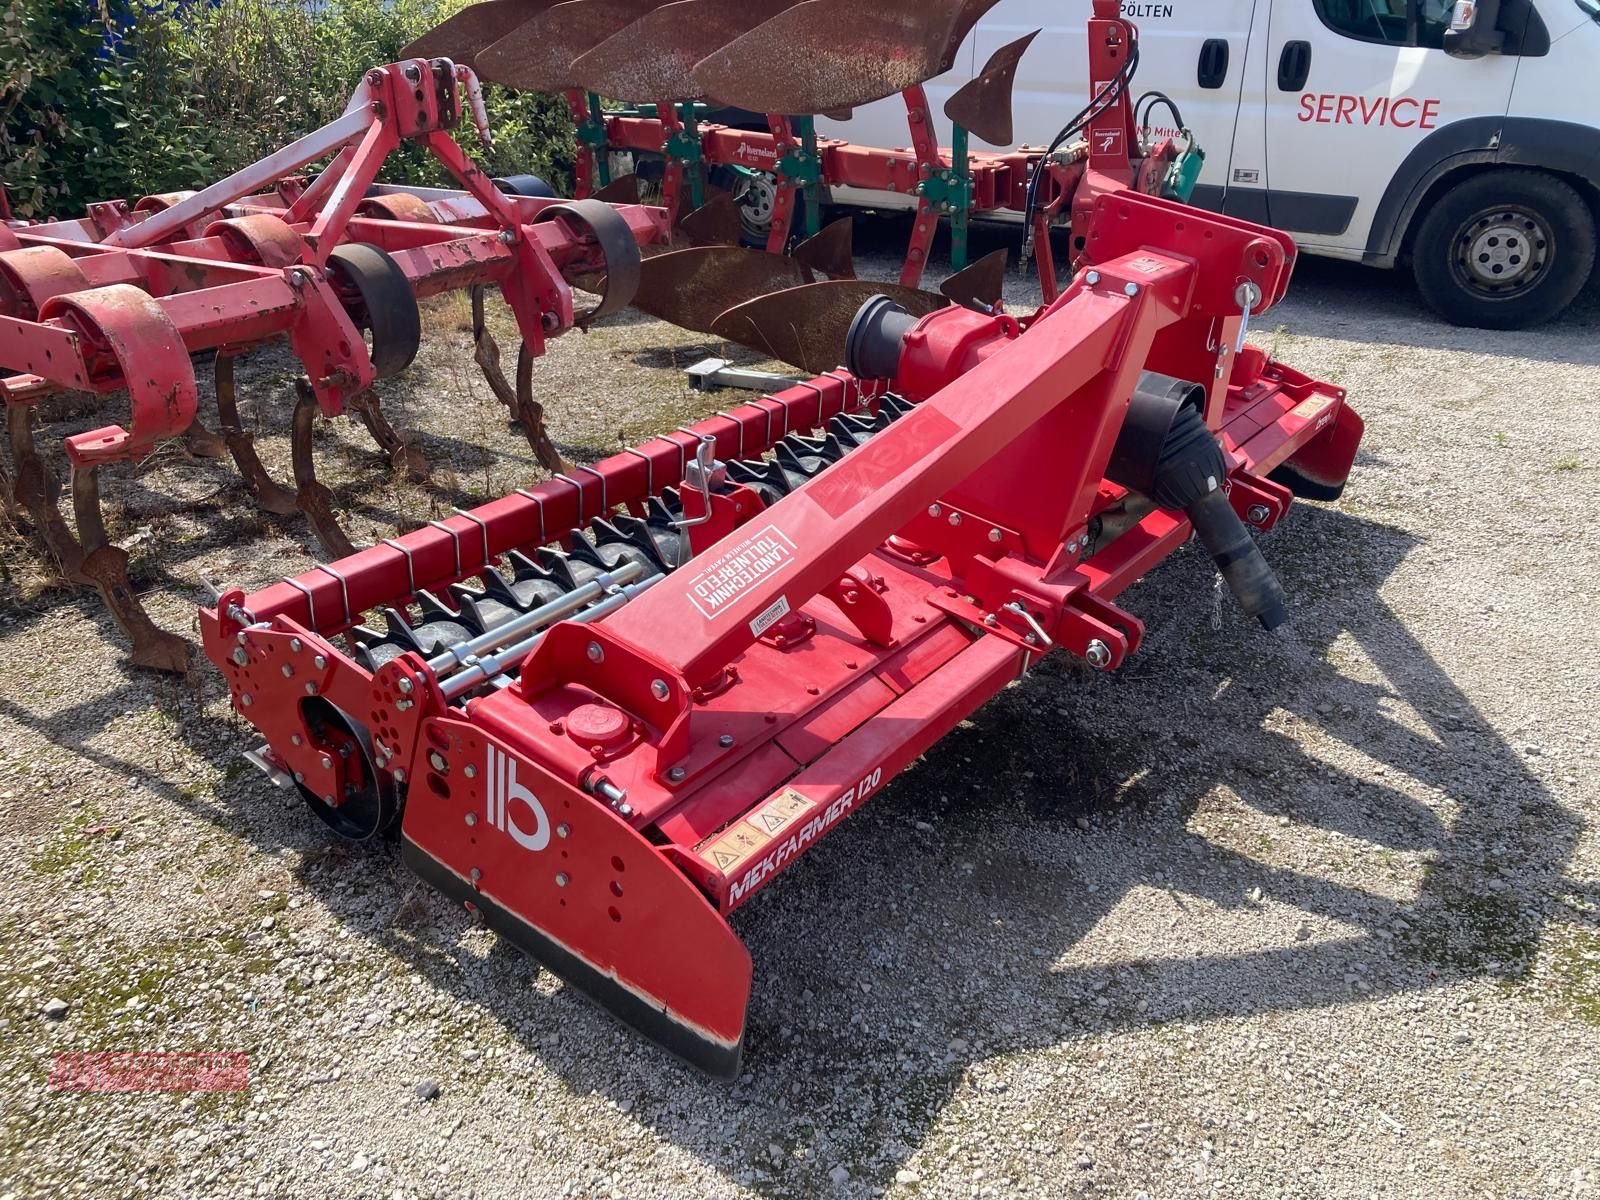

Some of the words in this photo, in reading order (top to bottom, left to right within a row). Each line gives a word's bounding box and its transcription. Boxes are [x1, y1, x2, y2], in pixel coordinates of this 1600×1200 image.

[1120, 1, 1172, 17] PÖLTEN
[1297, 93, 1440, 129] SERVICE
[1154, 127, 1181, 137] Mitte
[725, 539, 752, 560] WILHELM
[694, 536, 779, 597] TULLNERFELD
[704, 545, 790, 609] LANDTECHNIK
[857, 767, 882, 800] 120
